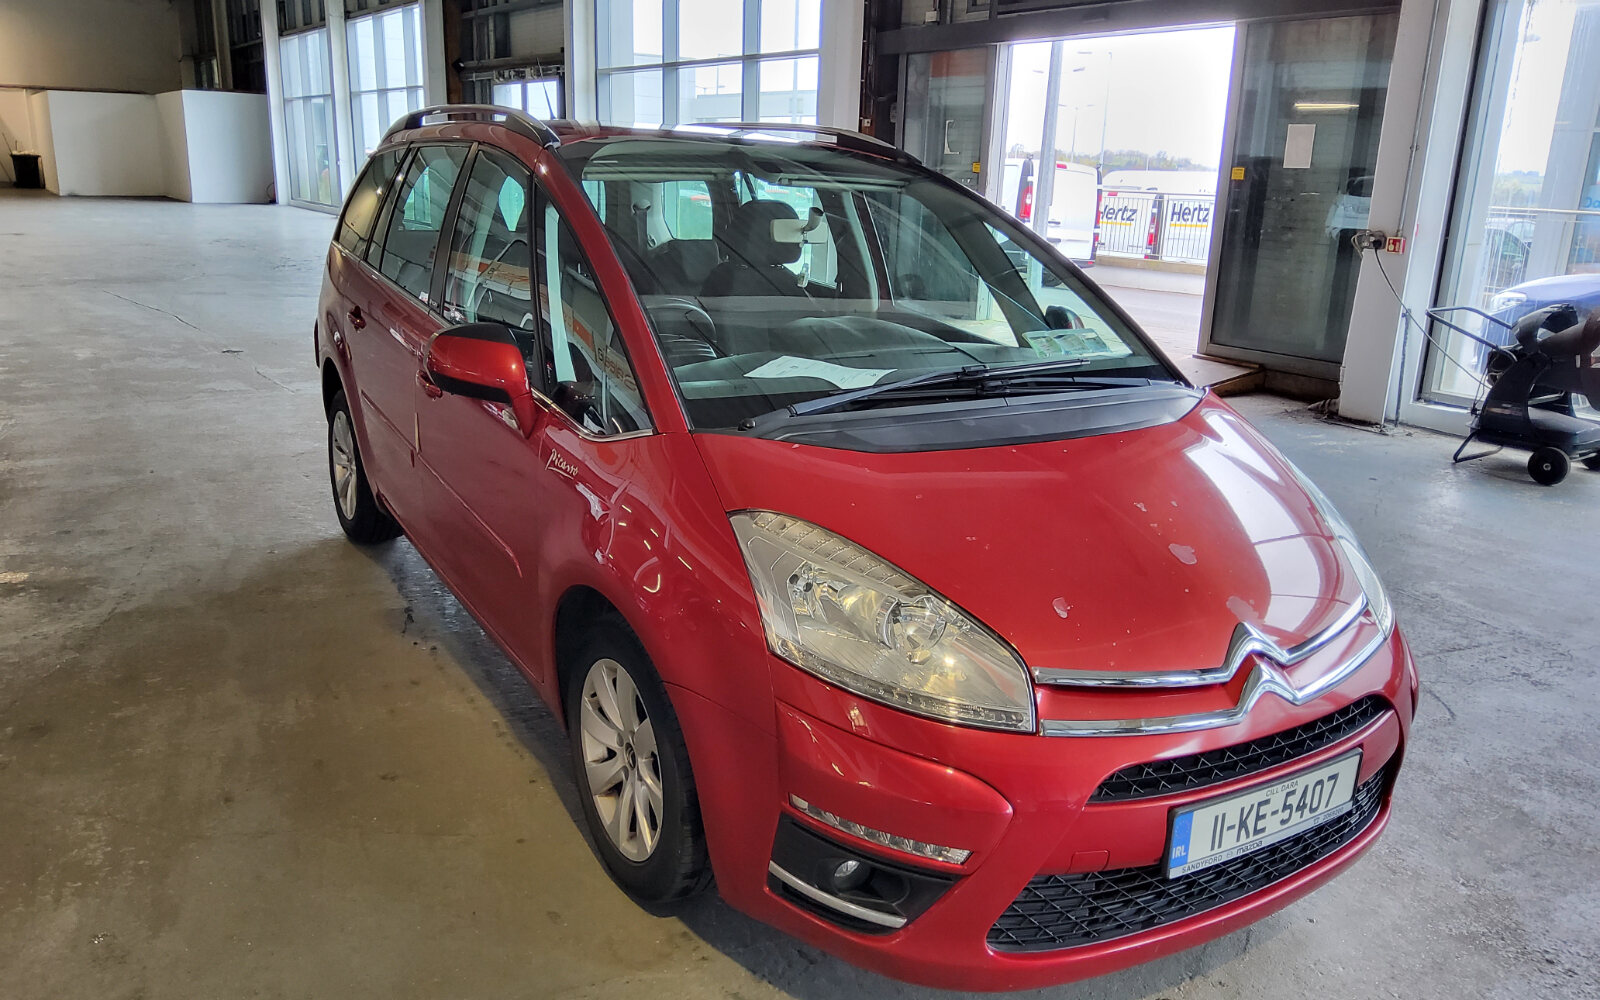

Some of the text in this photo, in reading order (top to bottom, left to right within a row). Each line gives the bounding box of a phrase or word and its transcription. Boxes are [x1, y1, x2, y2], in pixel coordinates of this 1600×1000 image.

[1171, 203, 1210, 222] Hertz
[545, 448, 579, 477] Picasso
[1281, 780, 1299, 791] DARA
[1210, 772, 1340, 851] 11-KE-5407
[1171, 845, 1187, 859] IRL
[1182, 854, 1223, 874] SANDYFORD
